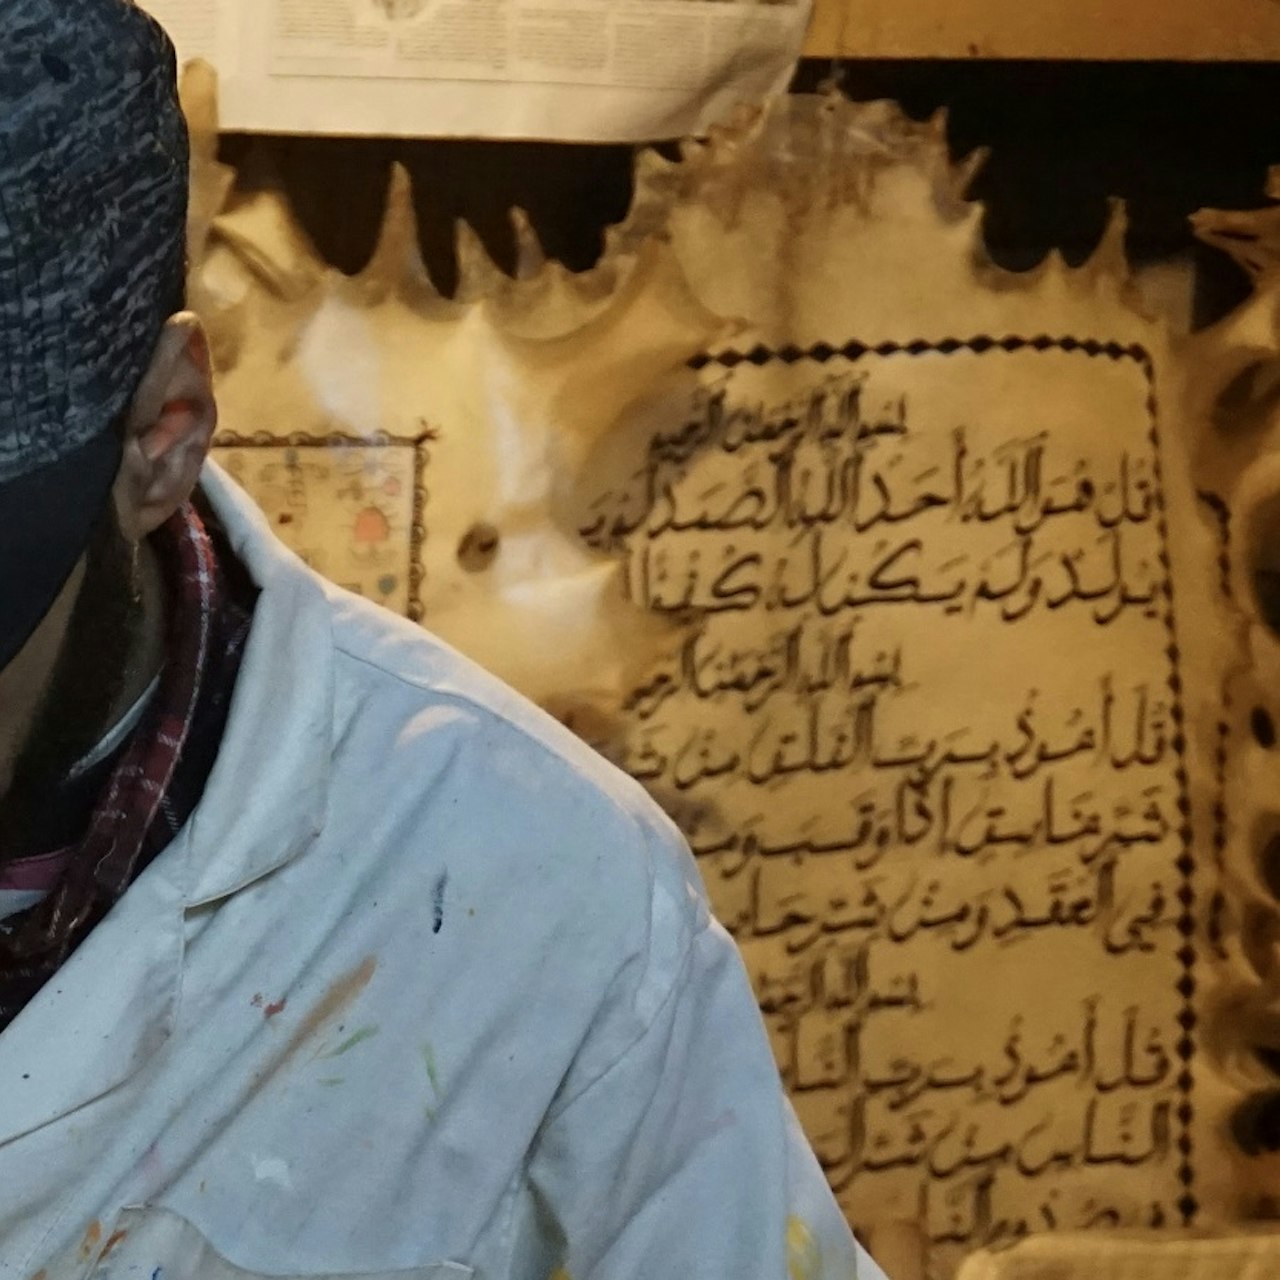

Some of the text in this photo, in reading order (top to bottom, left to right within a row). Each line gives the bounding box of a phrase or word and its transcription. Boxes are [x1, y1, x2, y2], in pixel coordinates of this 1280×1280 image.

[1096, 450, 1154, 528] قل
[1111, 682, 1167, 770] قل
[1095, 1005, 1171, 1092] قل
